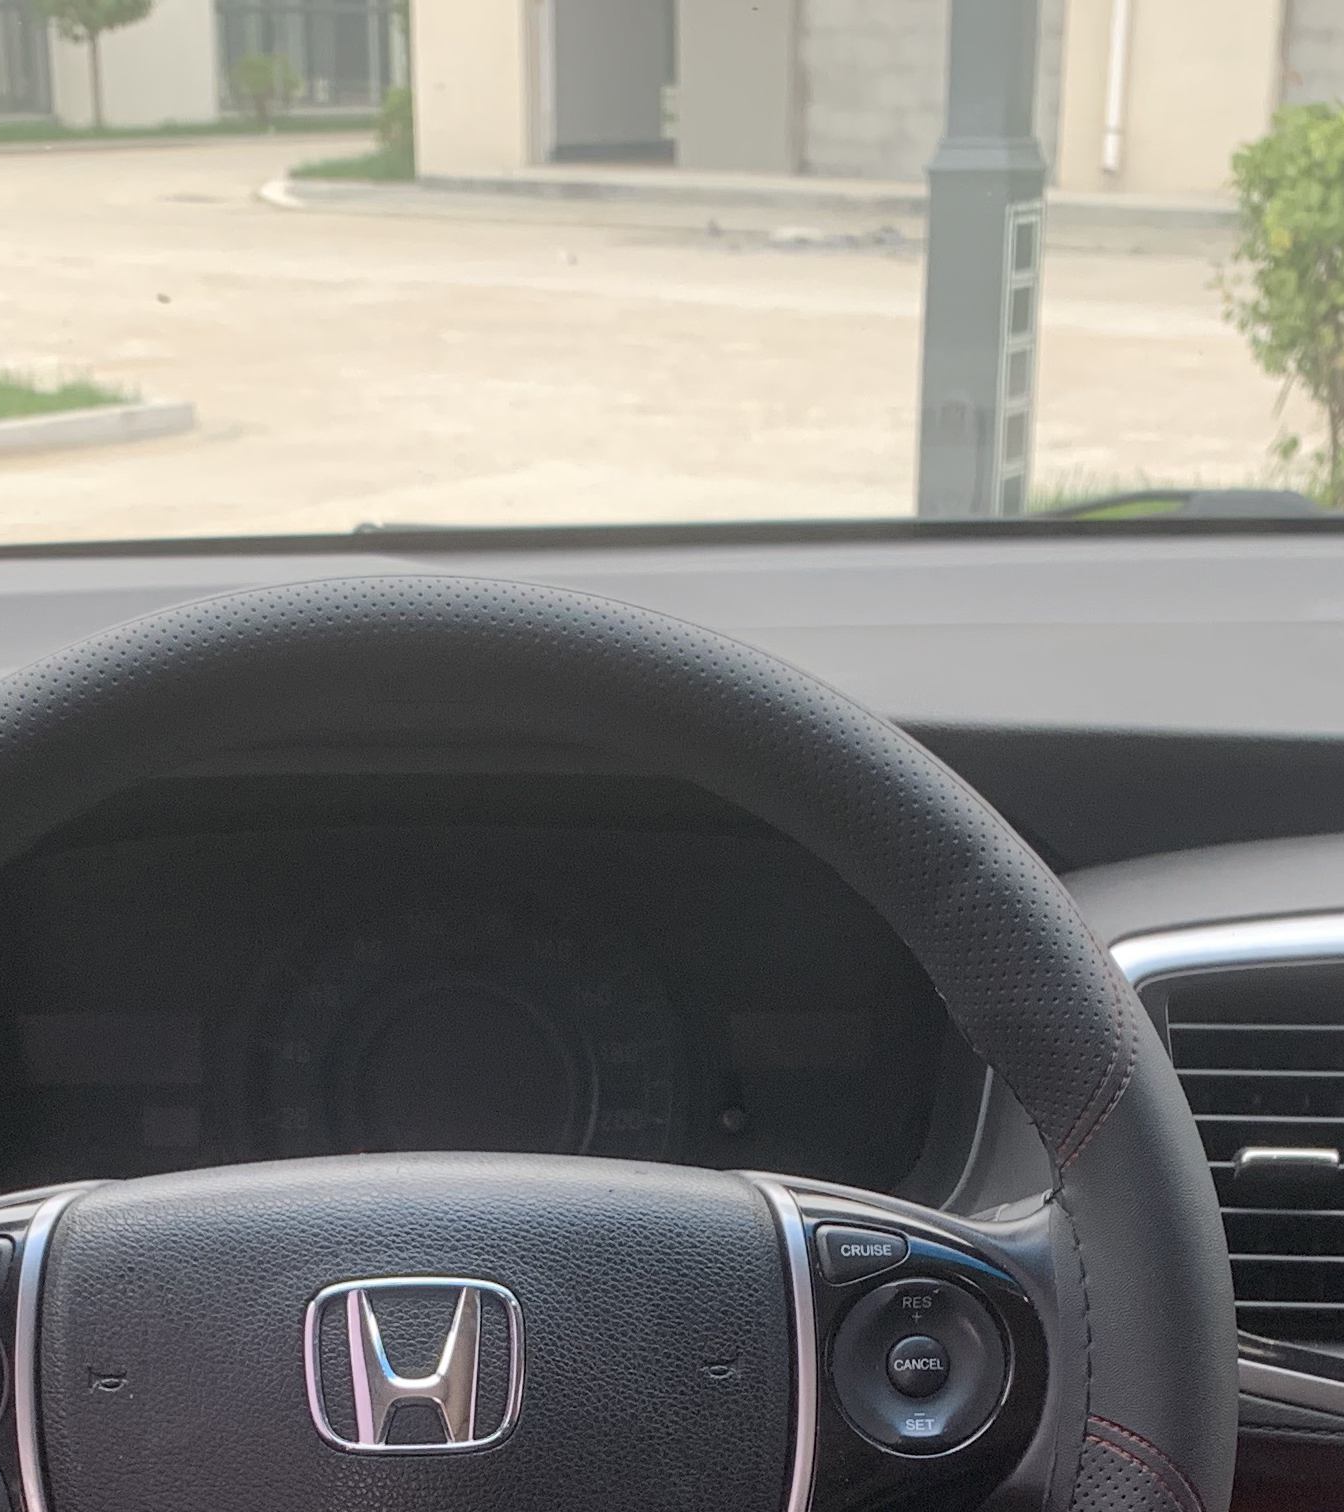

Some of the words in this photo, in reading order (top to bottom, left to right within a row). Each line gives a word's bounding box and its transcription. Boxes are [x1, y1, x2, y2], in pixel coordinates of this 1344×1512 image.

[840, 1244, 893, 1257] CRUISE
[902, 1296, 932, 1309] RES
[893, 1358, 944, 1371] CANCEL
[905, 1418, 935, 1432] SET
